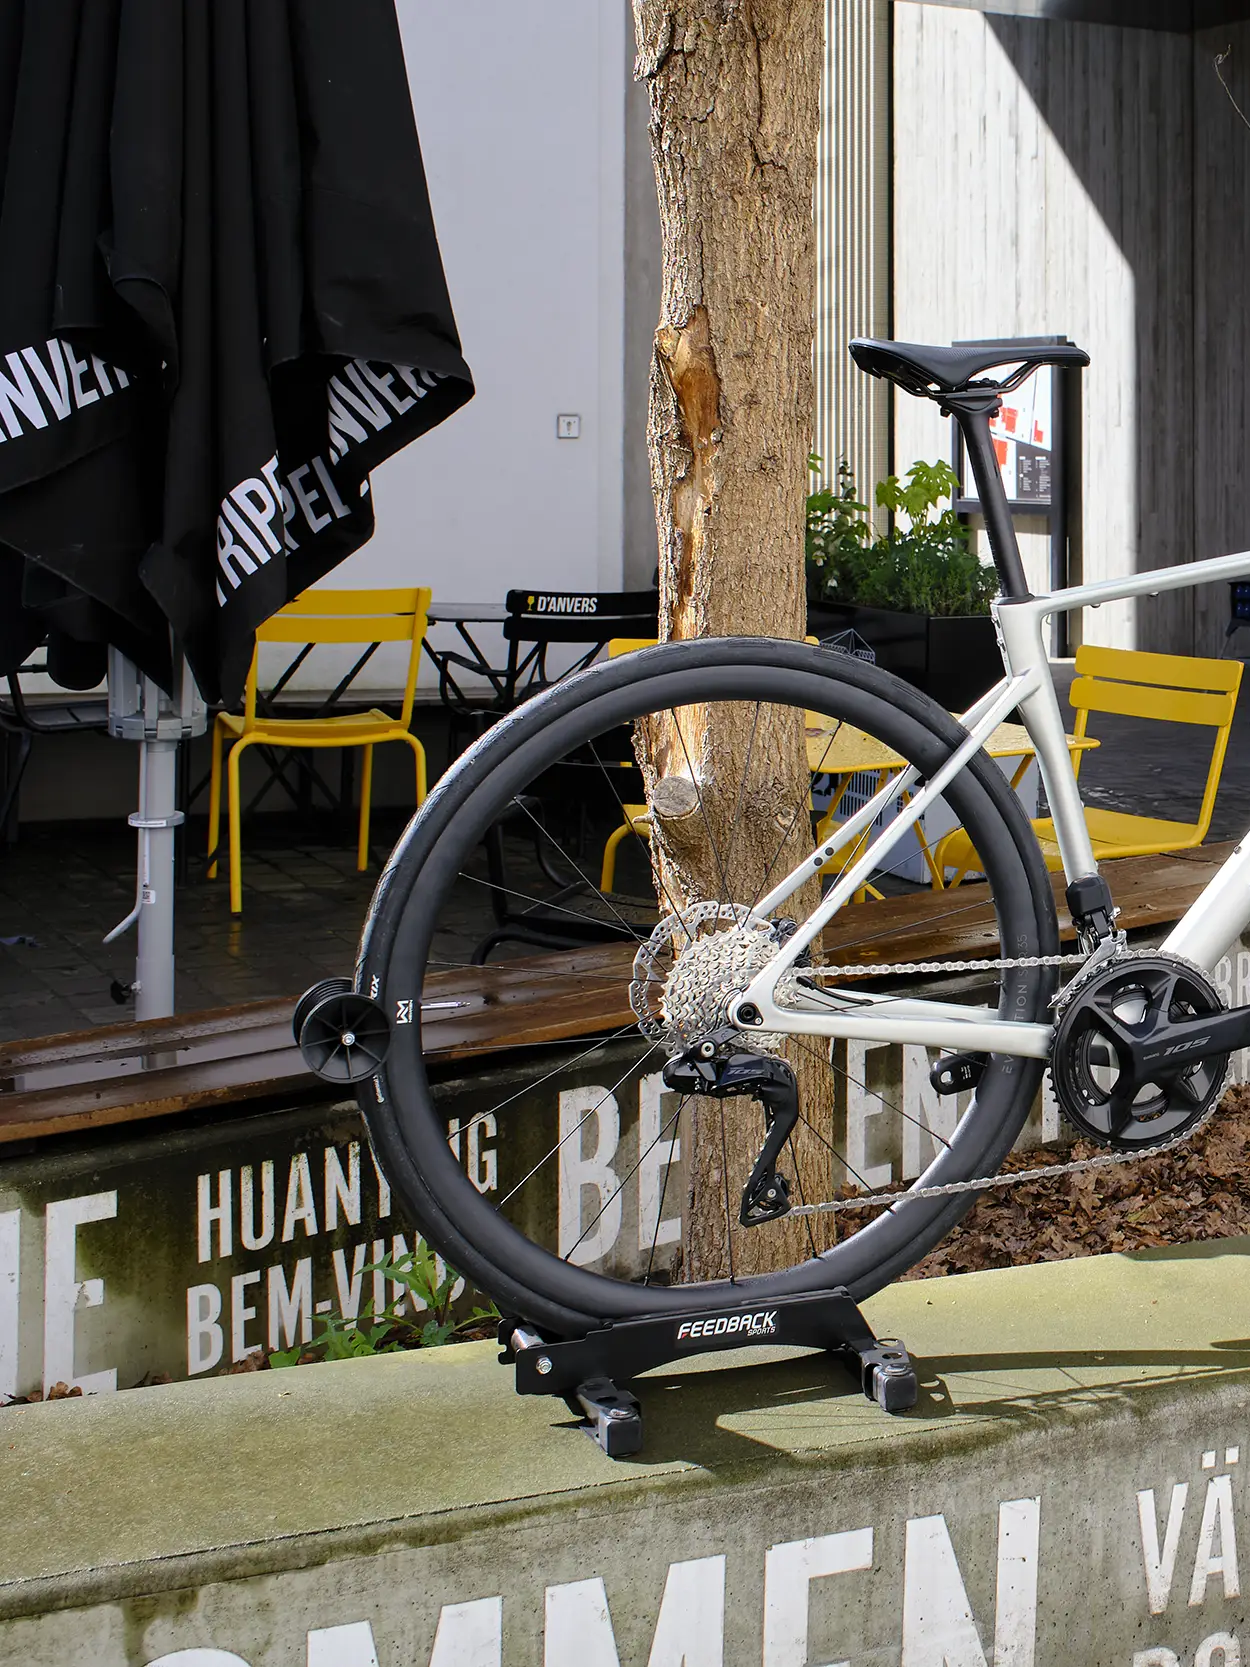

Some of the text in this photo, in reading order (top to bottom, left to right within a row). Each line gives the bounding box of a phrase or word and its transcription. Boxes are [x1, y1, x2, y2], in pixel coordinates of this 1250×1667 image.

[0, 338, 136, 443] NVE
[537, 596, 598, 613] D'ANVERS
[1163, 1035, 1212, 1056] 105
[197, 1112, 498, 1263] HUANYG
[677, 1311, 778, 1340] FEEDBACK
[747, 1326, 777, 1337] SPORTS
